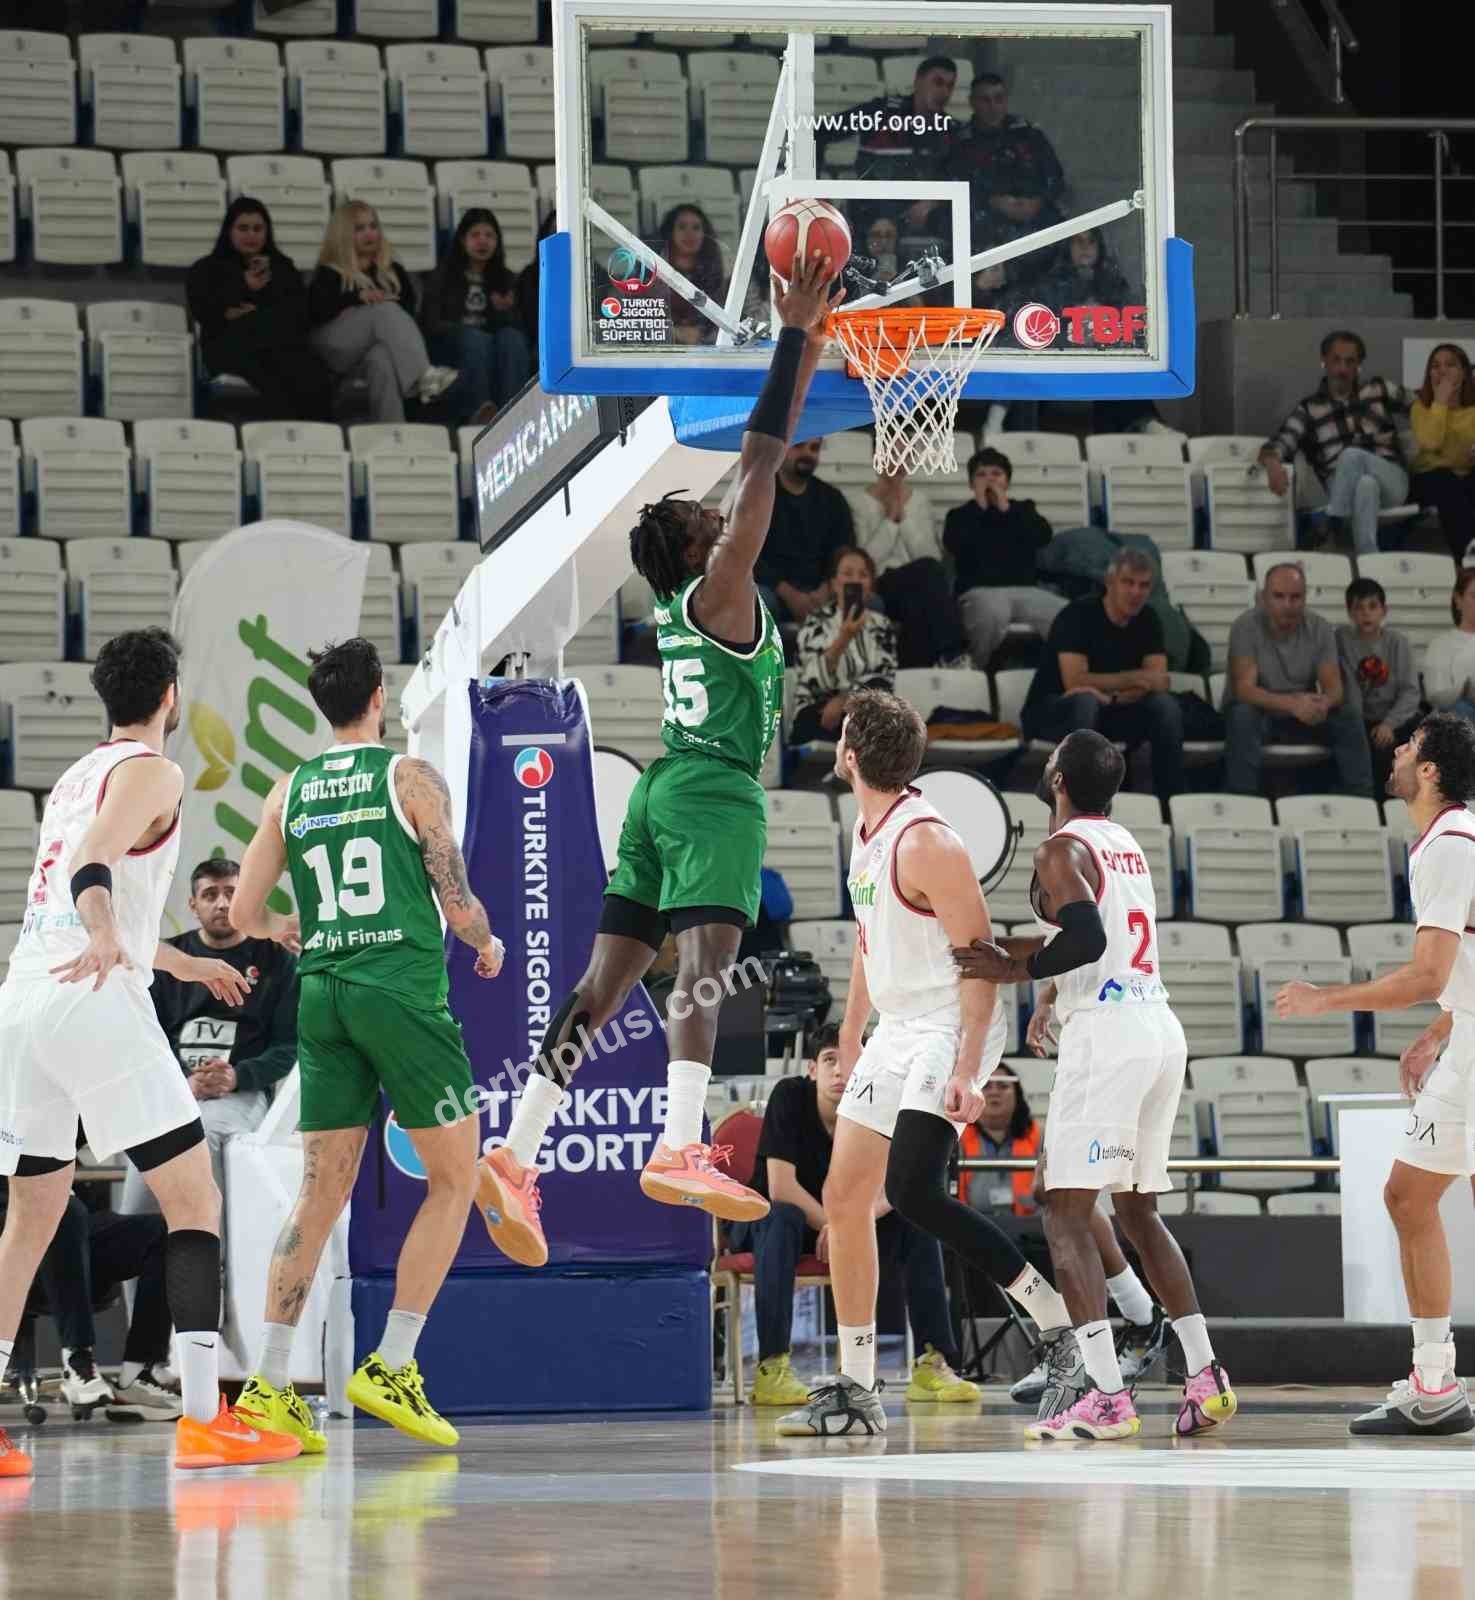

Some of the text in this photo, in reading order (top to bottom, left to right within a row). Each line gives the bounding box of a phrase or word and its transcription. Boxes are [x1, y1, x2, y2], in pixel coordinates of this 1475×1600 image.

[784, 110, 952, 135] www.tbf.org.tr
[599, 318, 669, 329] BASKETBOL
[602, 328, 642, 341] SÜPER
[1062, 305, 1147, 344] TBF
[476, 392, 583, 512] MEDICANA
[302, 836, 386, 922] 19
[347, 928, 403, 946] Finans
[1127, 908, 1154, 977] 2
[194, 1020, 225, 1040] TV
